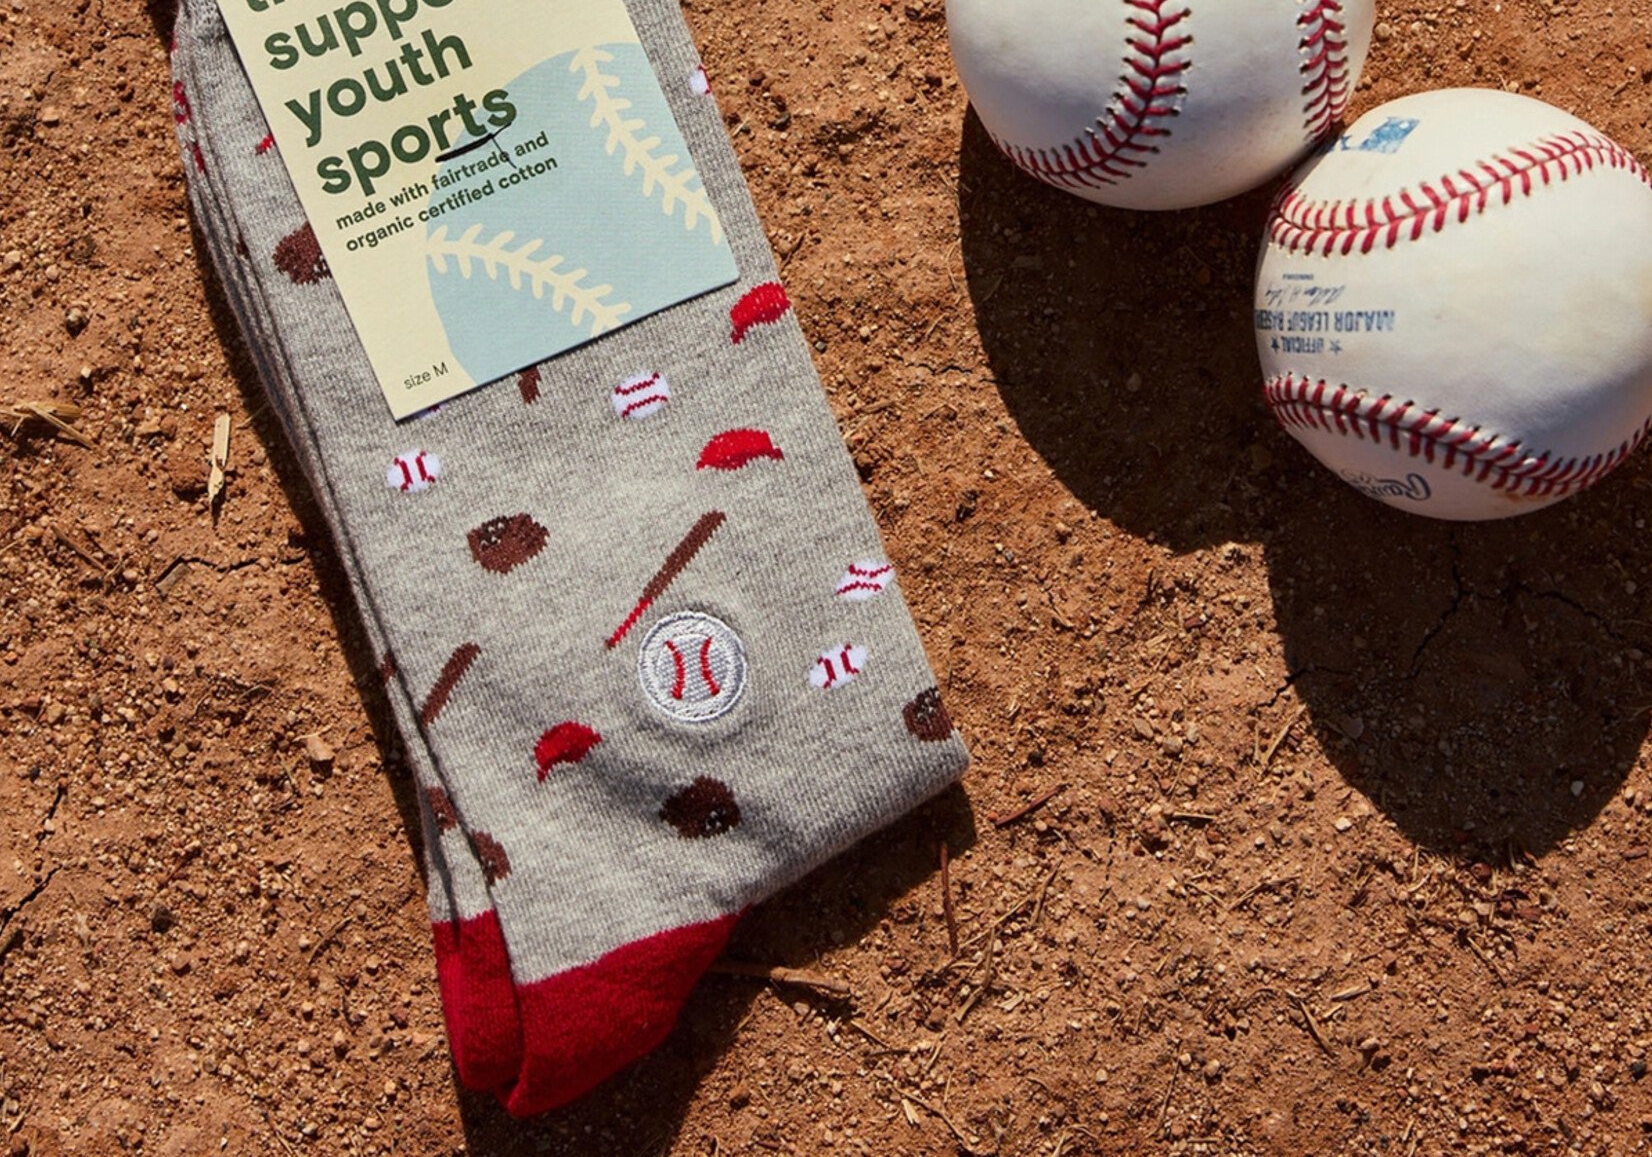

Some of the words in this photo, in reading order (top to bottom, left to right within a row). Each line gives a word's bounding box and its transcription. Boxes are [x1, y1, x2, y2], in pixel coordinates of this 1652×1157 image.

[284, 29, 473, 148] youth
[316, 88, 518, 198] sports
[335, 201, 387, 230] made
[389, 182, 430, 208] with
[431, 150, 511, 191] fairtrade
[513, 130, 550, 158] and
[346, 216, 415, 252] organic
[417, 179, 496, 223] certified
[497, 156, 559, 190] cotton
[1280, 335, 1324, 354] OFFICIAL
[1334, 310, 1395, 333] MAJOR
[403, 371, 431, 390] size
[432, 361, 449, 377] M
